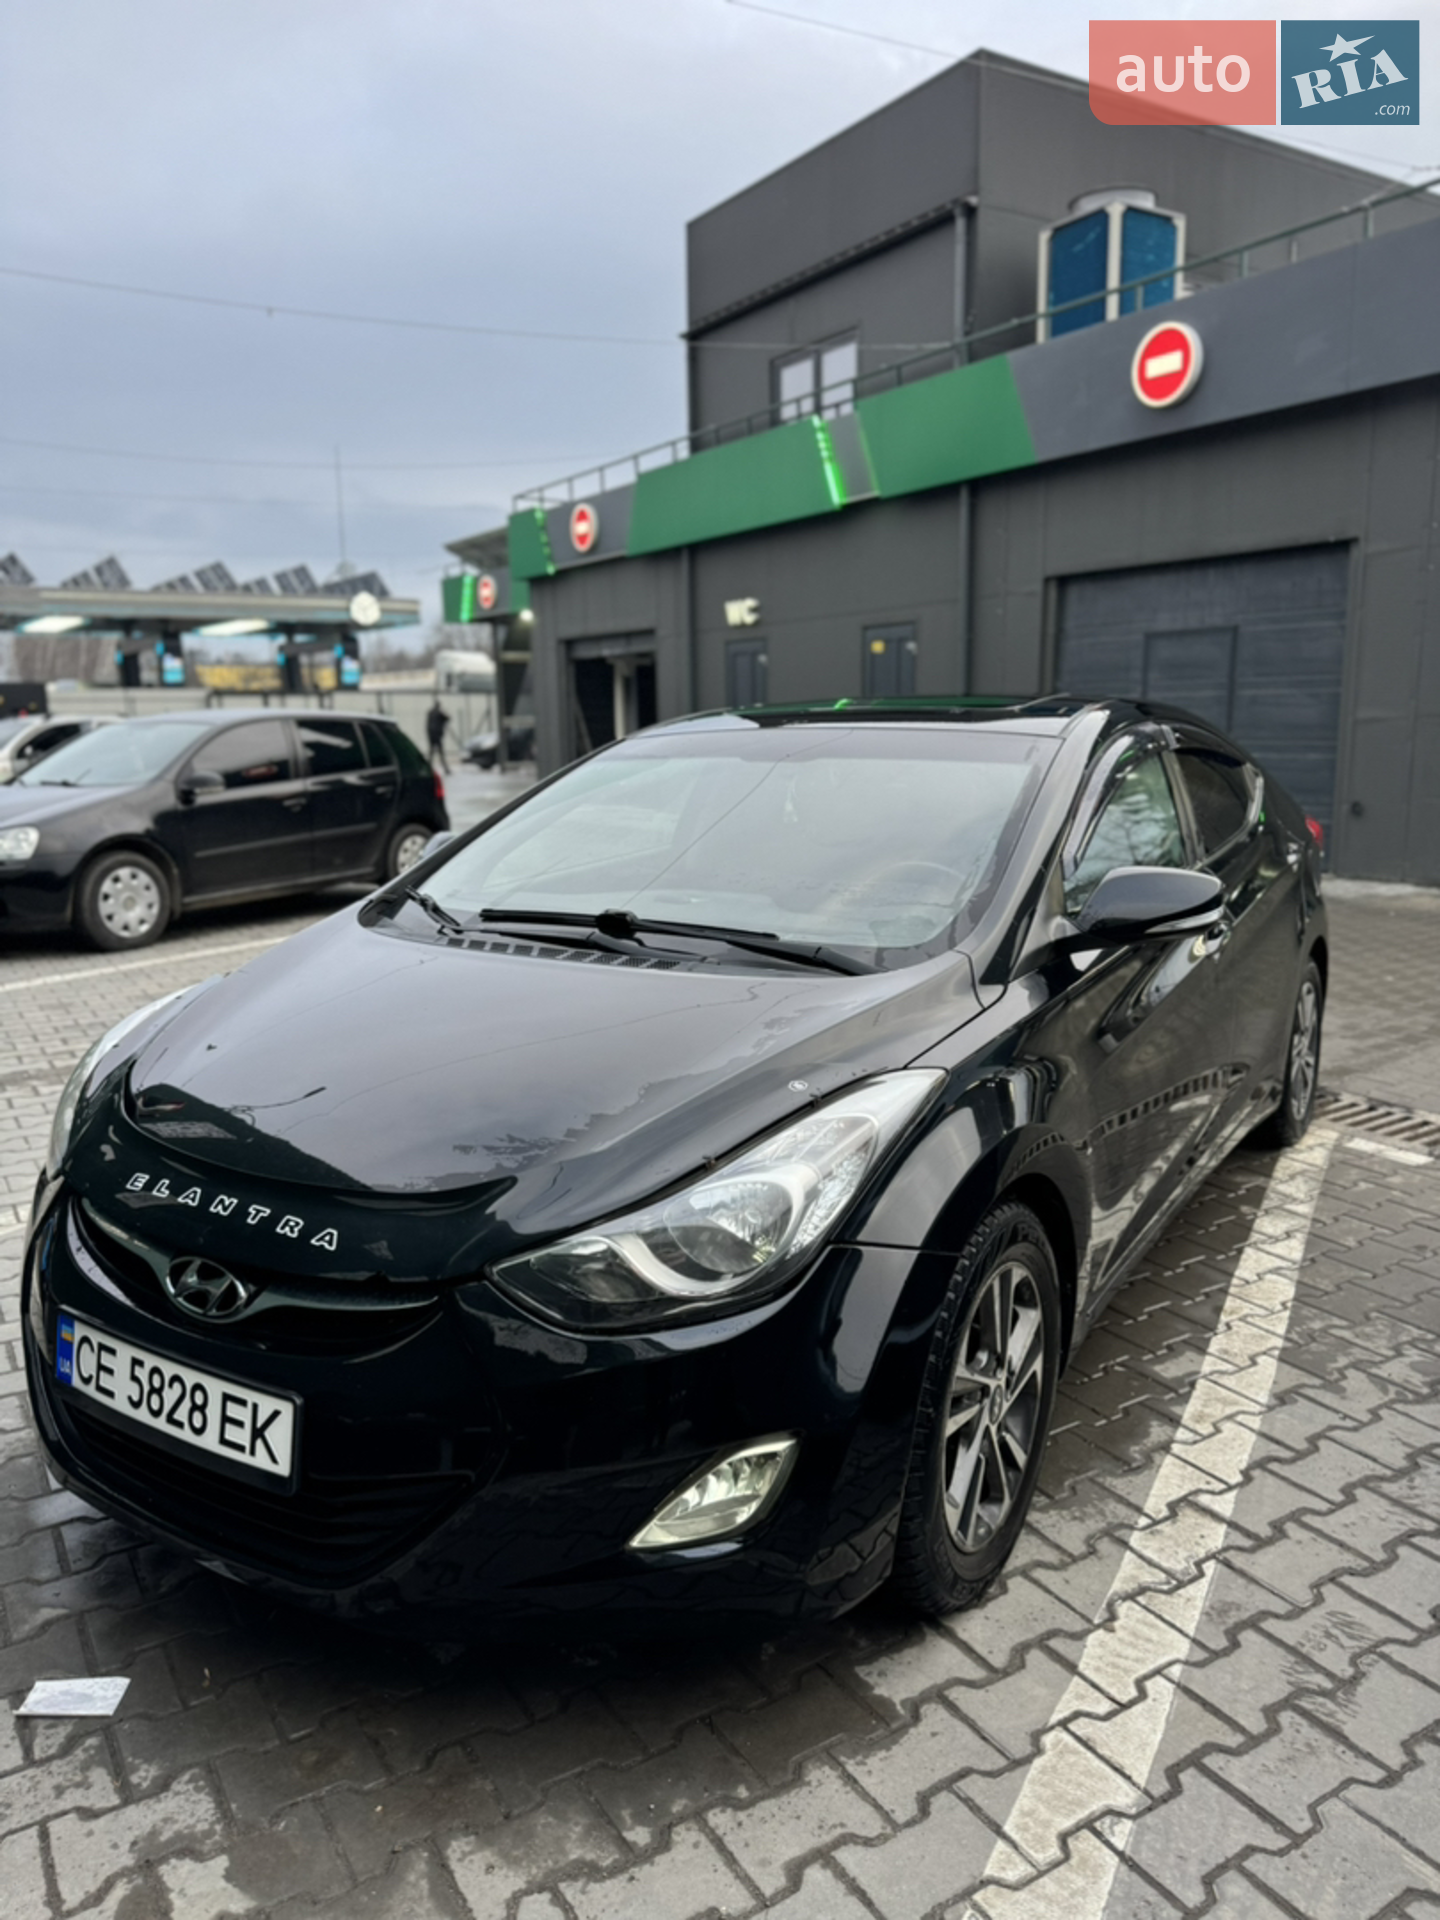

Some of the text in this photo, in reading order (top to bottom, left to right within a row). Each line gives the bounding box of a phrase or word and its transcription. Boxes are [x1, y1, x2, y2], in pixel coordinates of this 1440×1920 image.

[126, 1173, 339, 1251] ELANTRA
[59, 1356, 72, 1375] UA
[75, 1335, 283, 1466] CE 5828 EK
